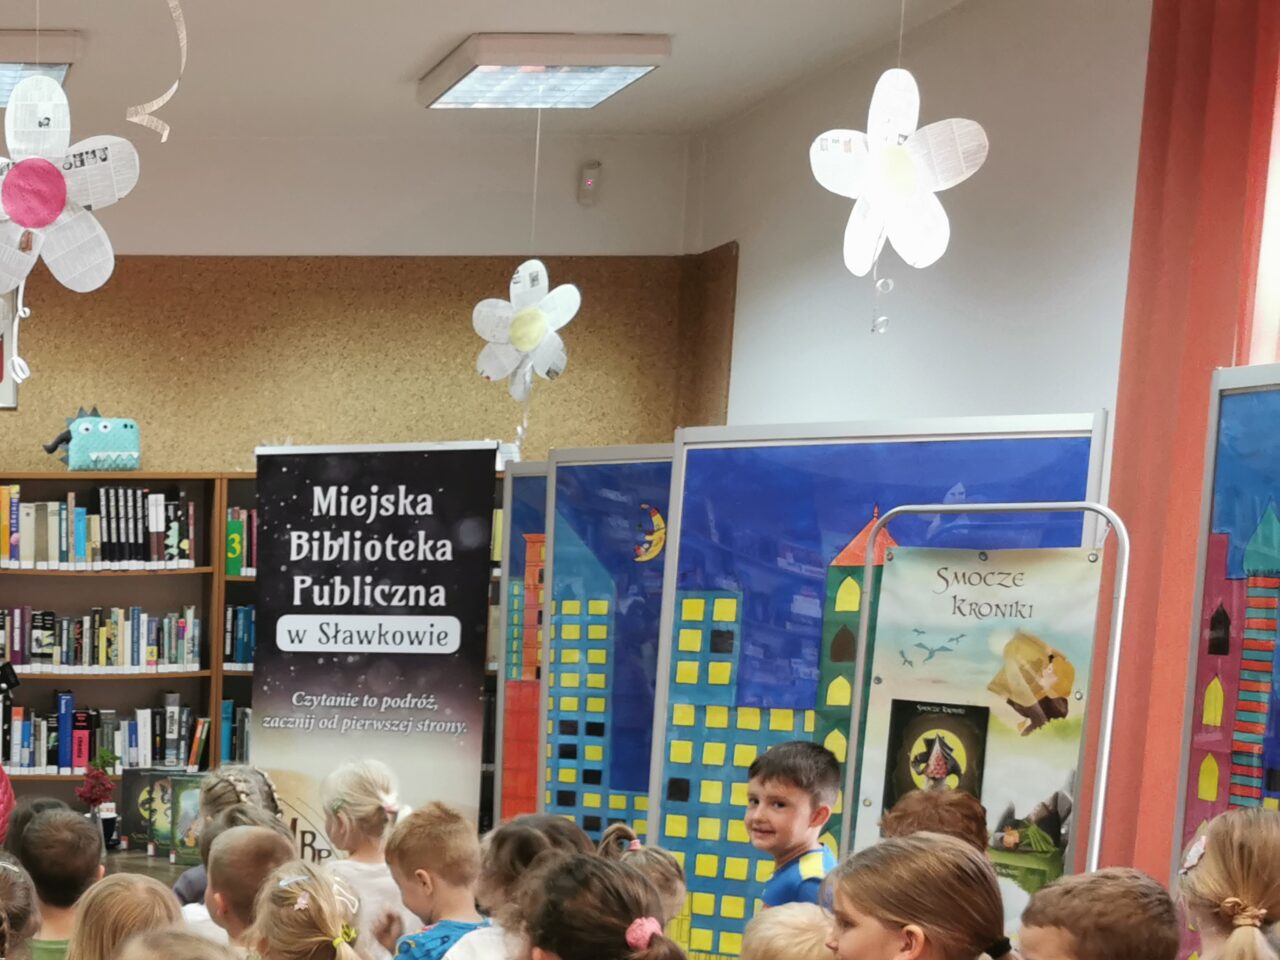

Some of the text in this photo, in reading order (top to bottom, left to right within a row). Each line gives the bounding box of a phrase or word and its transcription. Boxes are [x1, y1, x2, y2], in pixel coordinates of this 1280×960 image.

[312, 485, 434, 524] Miejska
[227, 533, 241, 559] 3
[289, 530, 454, 561] Biblioteka
[292, 575, 447, 606] Publiczna
[287, 622, 449, 646] w Sławkowie
[291, 691, 439, 712] Czytanie to podróż,
[262, 714, 468, 737] zacznij od pierwszej strony.
